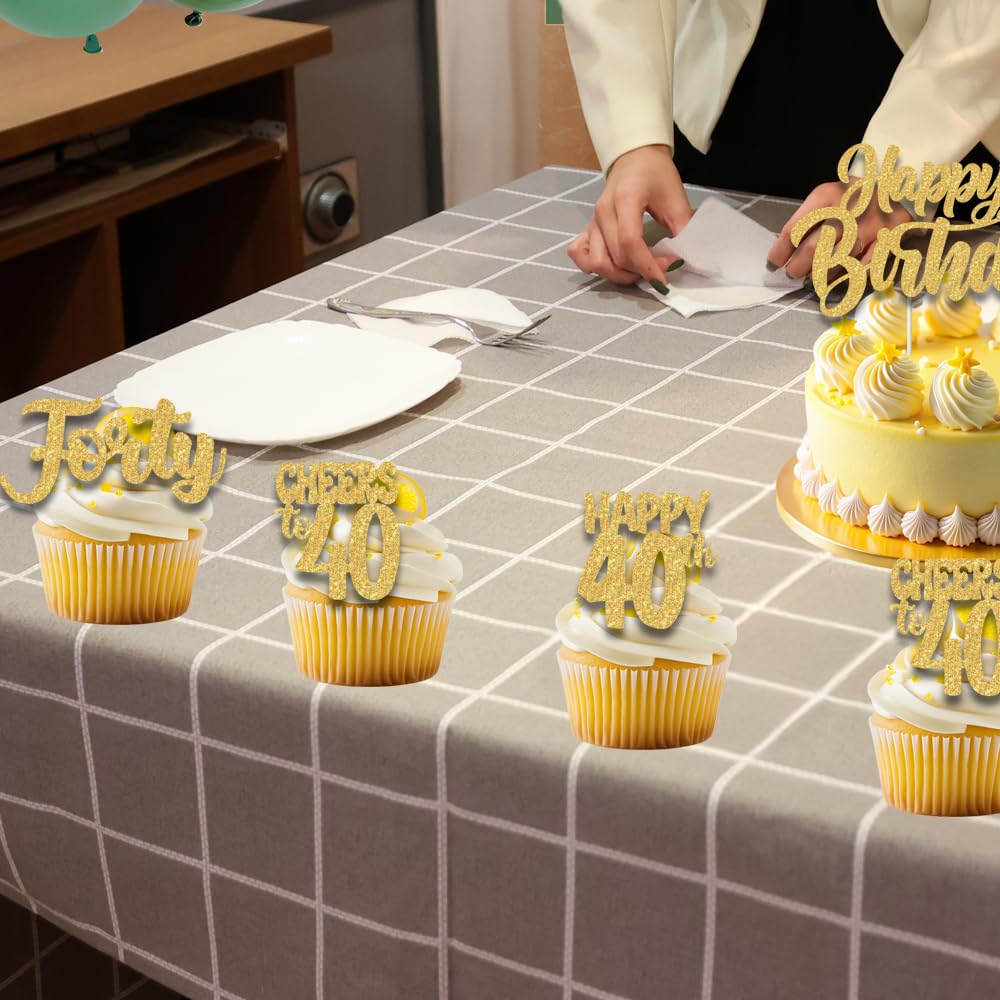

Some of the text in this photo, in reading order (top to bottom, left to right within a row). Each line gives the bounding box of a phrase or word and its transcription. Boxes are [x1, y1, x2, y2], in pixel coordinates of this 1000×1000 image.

[0, 397, 227, 504] Forty
[276, 461, 399, 504] CHEERS
[584, 489, 711, 534] HAPPY
[274, 503, 401, 600] to 40
[577, 531, 718, 630] 40th
[889, 600, 927, 636] to
